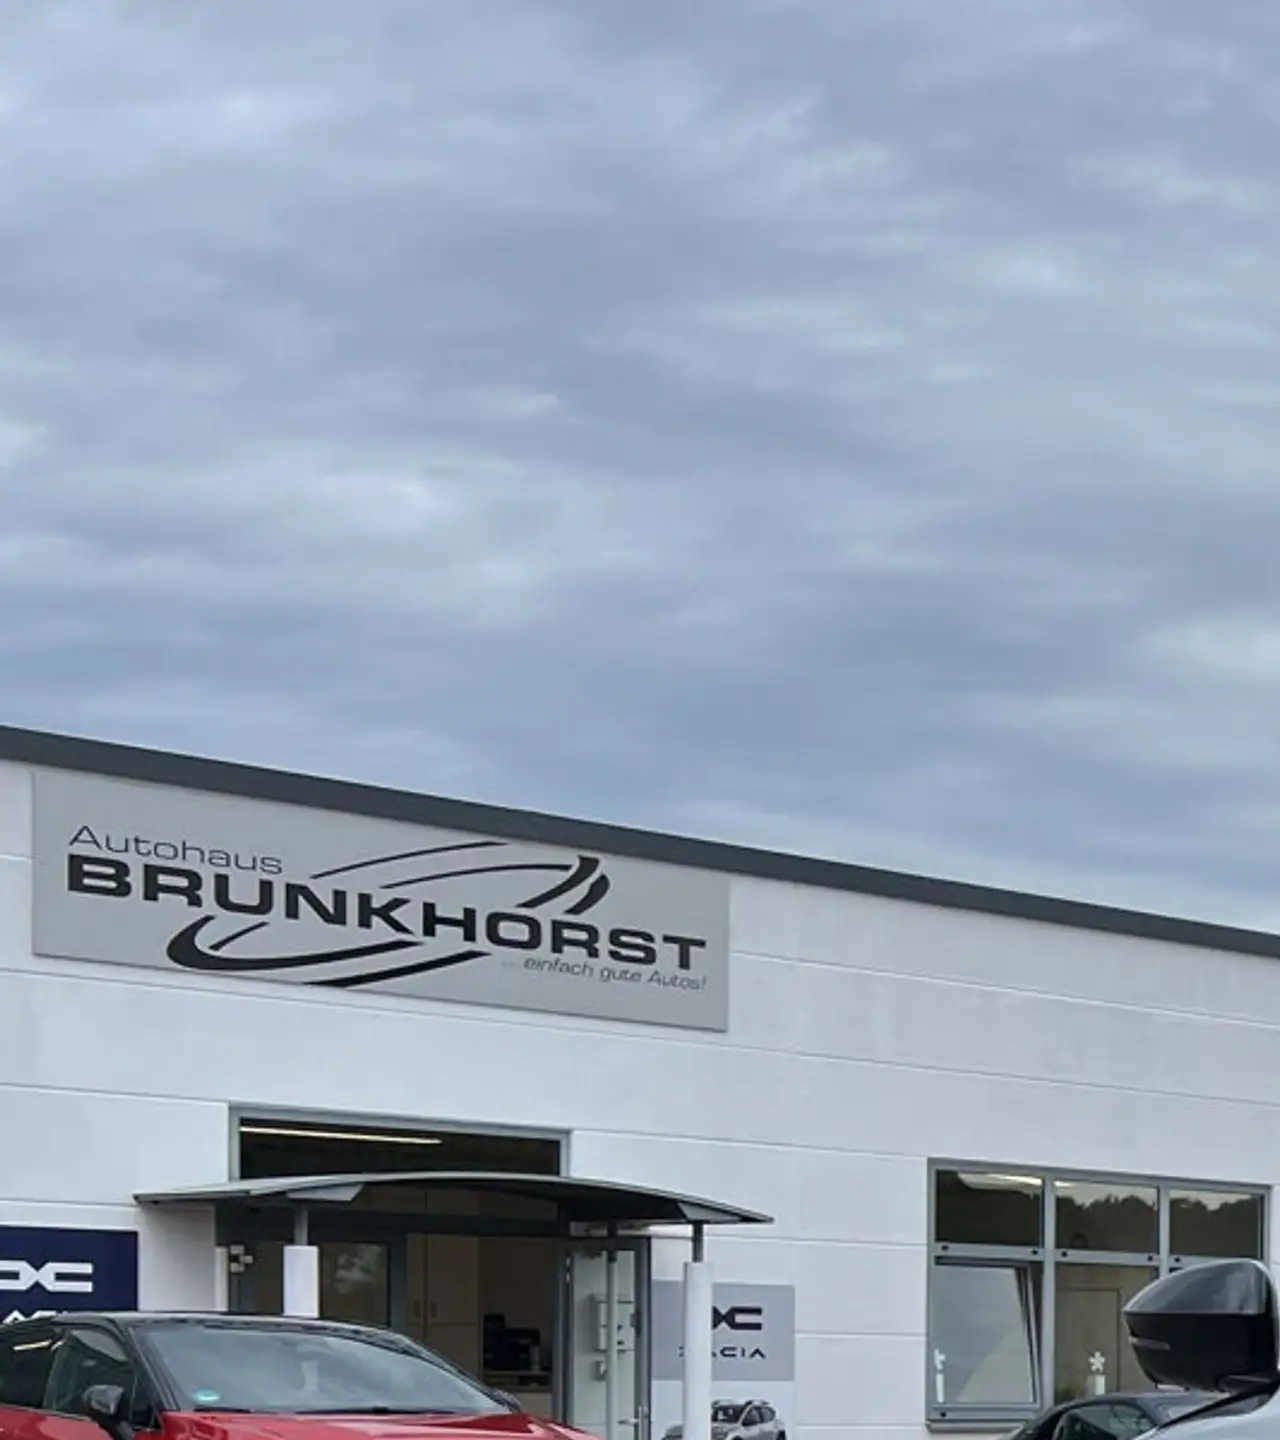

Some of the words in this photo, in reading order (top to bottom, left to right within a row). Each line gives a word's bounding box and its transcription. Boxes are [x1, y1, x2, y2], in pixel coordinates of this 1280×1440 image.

[69, 825, 283, 874] Autohaus
[67, 854, 707, 971] BRUNKHORST
[600, 967, 642, 983] gute
